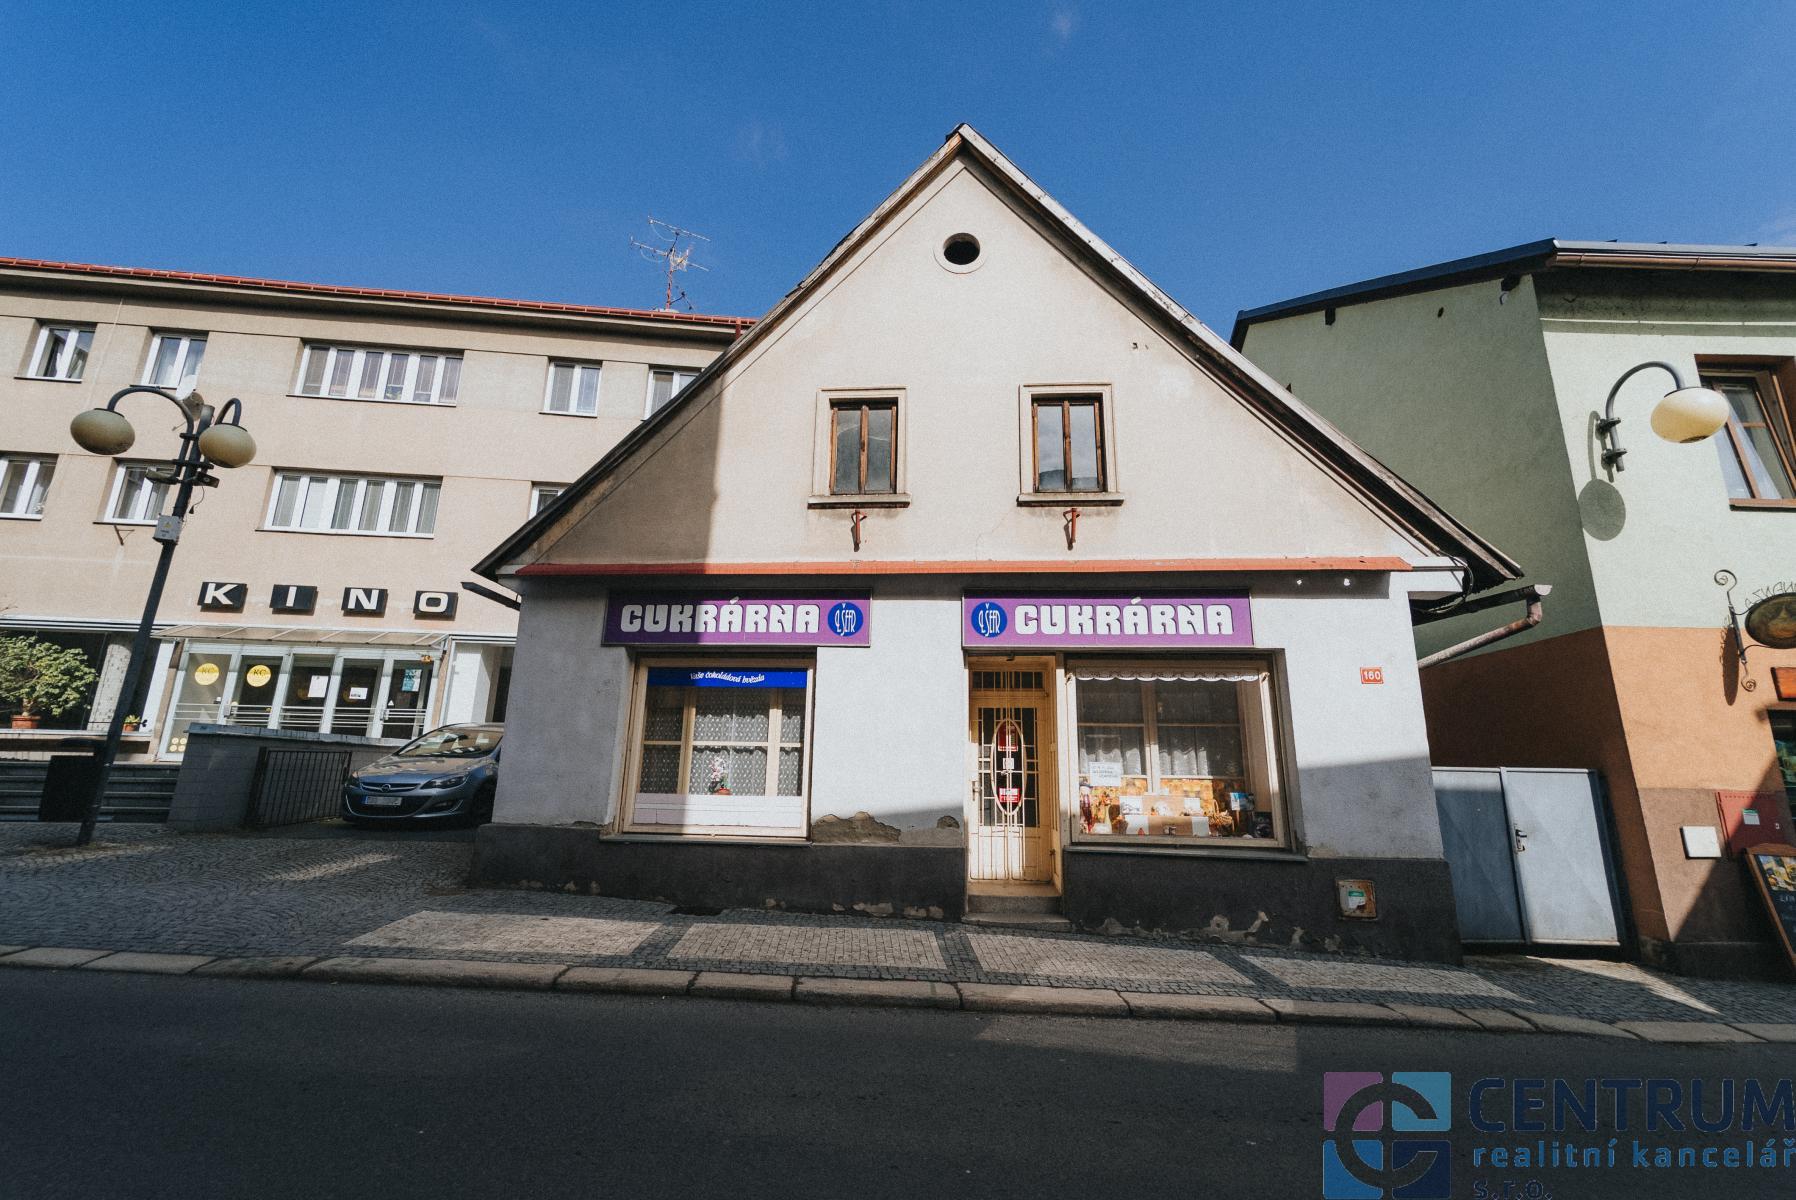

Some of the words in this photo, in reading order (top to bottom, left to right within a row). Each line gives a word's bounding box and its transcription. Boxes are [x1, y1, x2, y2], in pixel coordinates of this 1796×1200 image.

[203, 582, 449, 613] KINO
[620, 596, 820, 633] CUKRÁRNA
[1014, 596, 1234, 635] CUKRÁRNA
